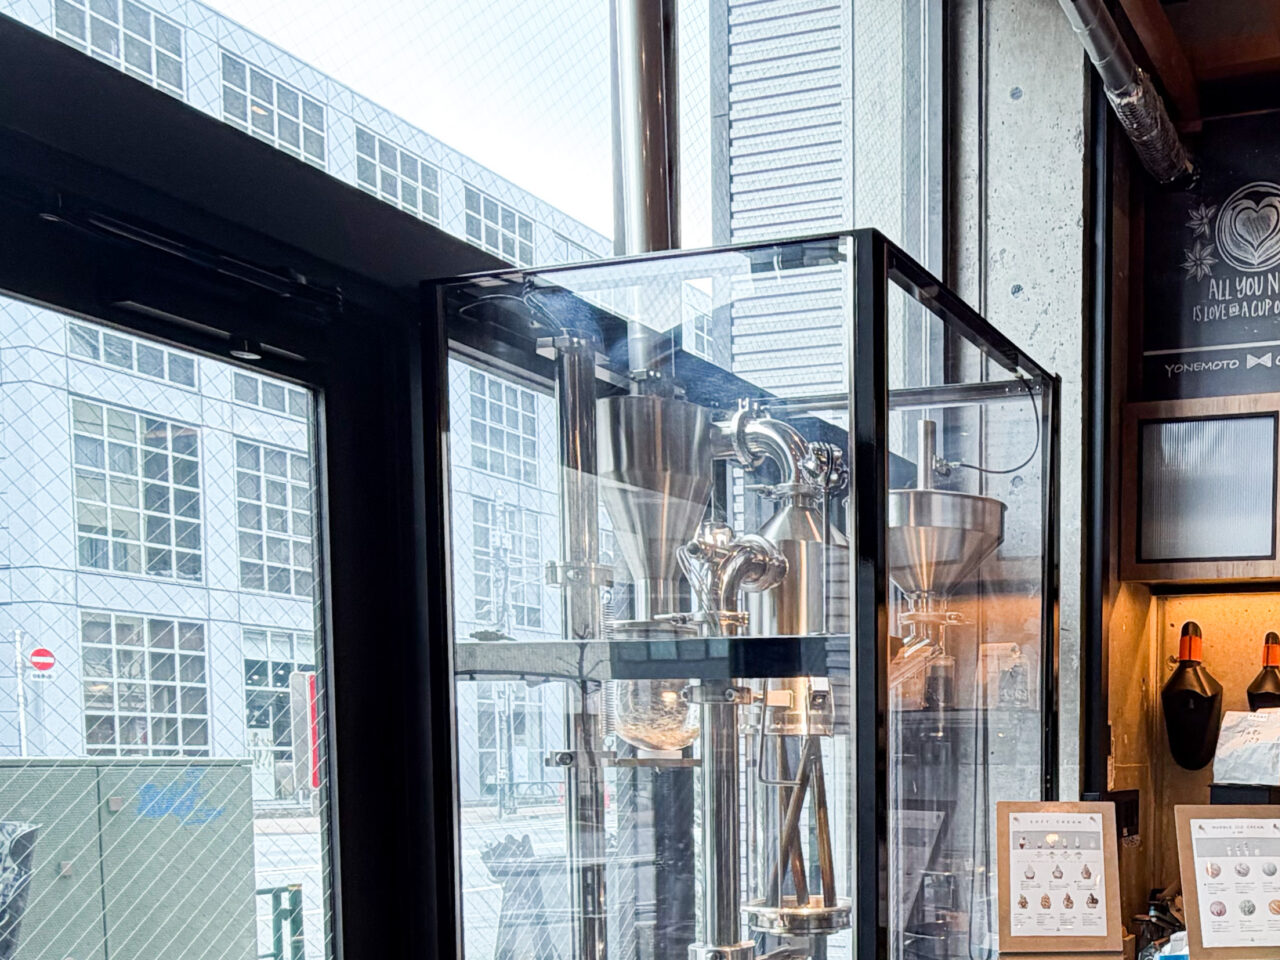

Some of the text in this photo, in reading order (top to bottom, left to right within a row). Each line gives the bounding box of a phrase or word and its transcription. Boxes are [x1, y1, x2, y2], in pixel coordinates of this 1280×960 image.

[1208, 278, 1233, 300] ALL
[1236, 275, 1264, 299] YOU
[1193, 304, 1202, 321] IS
[1204, 303, 1228, 322] LOVE
[1241, 301, 1249, 317] A
[1251, 299, 1272, 317] CUP
[1164, 359, 1240, 379] YONEMOTO
